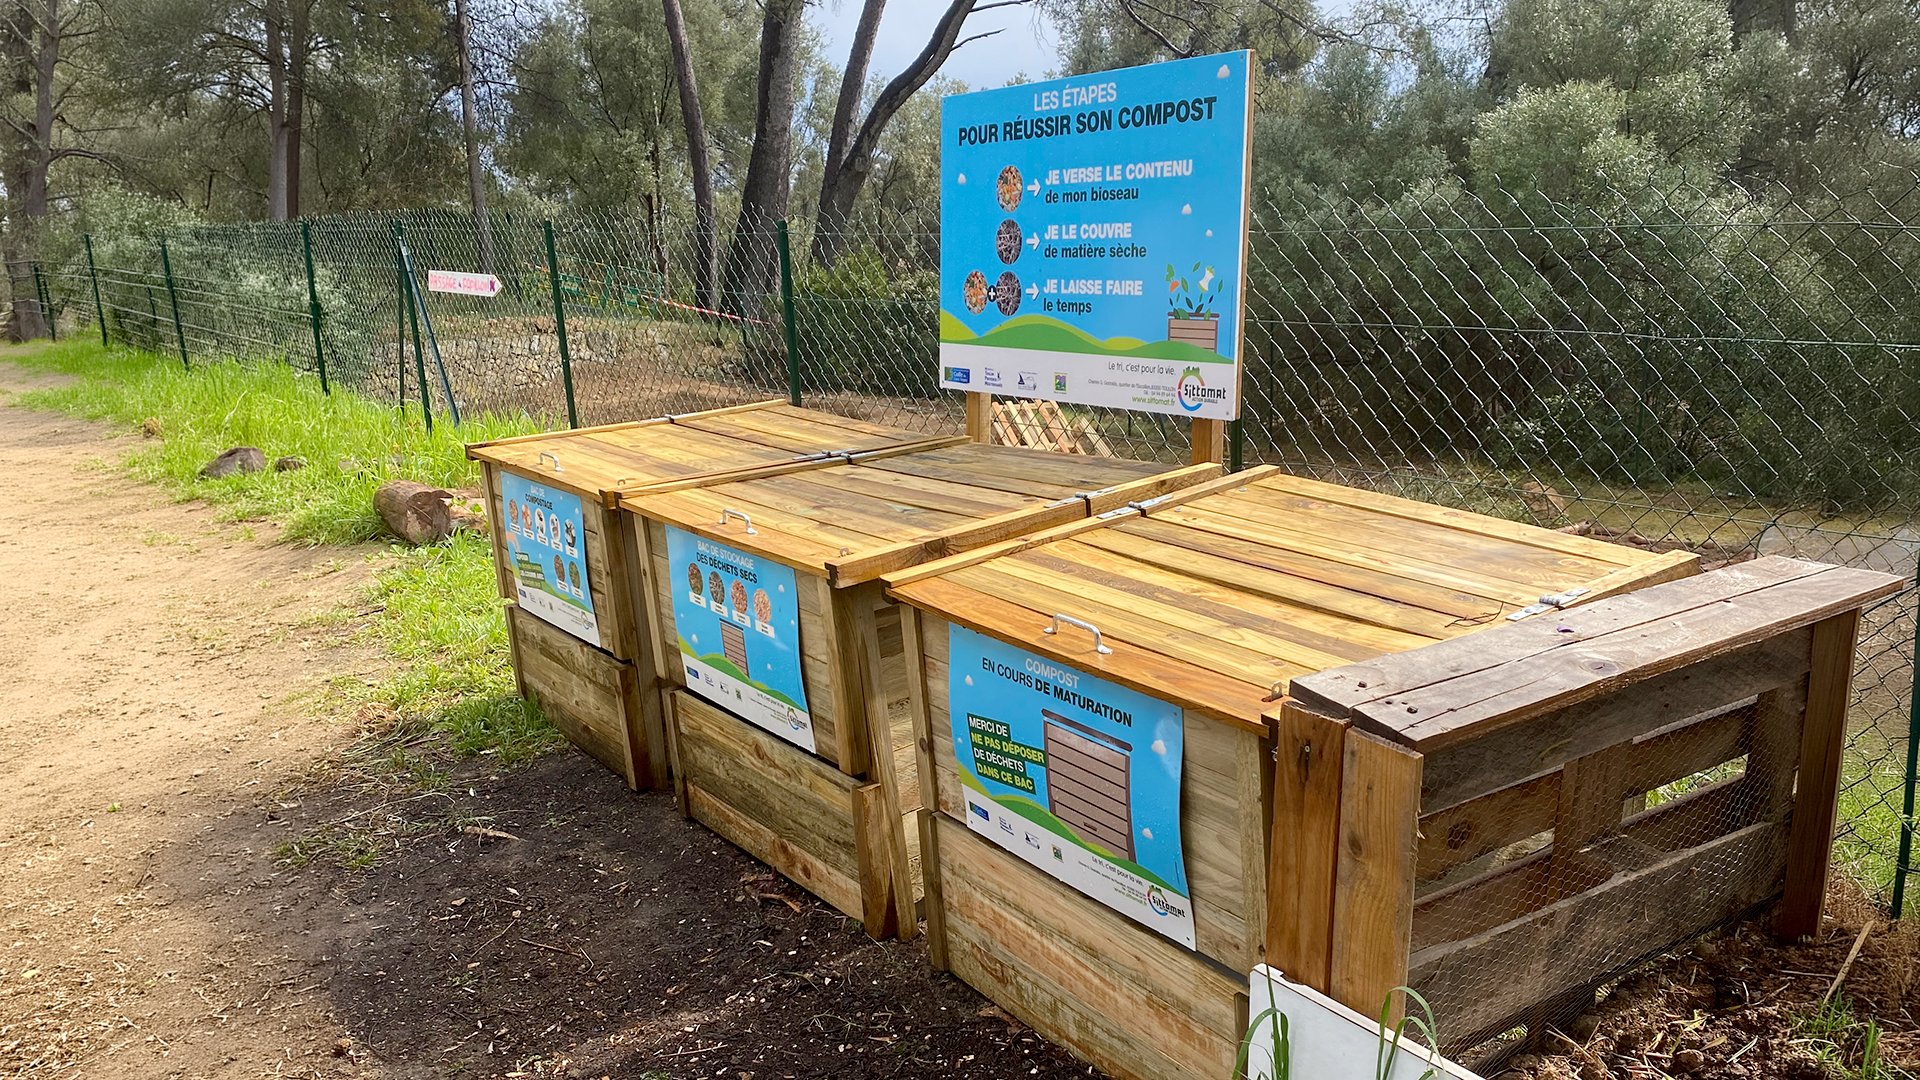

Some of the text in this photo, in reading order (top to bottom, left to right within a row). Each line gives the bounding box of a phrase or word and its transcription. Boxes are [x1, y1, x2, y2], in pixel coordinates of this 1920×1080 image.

[1034, 82, 1117, 112] LES ÉTAPES
[958, 96, 1217, 146] POUR RÉUSSIR SON COMPOST
[1045, 159, 1193, 186] JE VERSE LE CONTENU
[1045, 186, 1139, 204] de mon bioseau
[1044, 222, 1132, 240] JE LE COUVRE
[1044, 243, 1147, 258] de matière sèche
[1043, 279, 1143, 296] JE LAISSE FAIRE
[1043, 297, 1092, 315] le temps
[1108, 361, 1176, 376] Le tri, c'est pour la vie.
[1132, 396, 1176, 406] www.sittomat.fr
[697, 540, 754, 570] BAC DE STOCKAGE
[696, 552, 758, 584] DES DÉCHETS SECS
[1025, 658, 1079, 689] COMPOST
[982, 657, 1132, 727] EN COURS DE MATURATION
[968, 716, 1008, 737] MERCI DE
[971, 732, 1045, 763] NE PAS DÉPOSER
[973, 748, 1024, 772] DE DÉCHETS
[976, 763, 1033, 791] DANS CE BAC
[1117, 868, 1129, 879] pour
